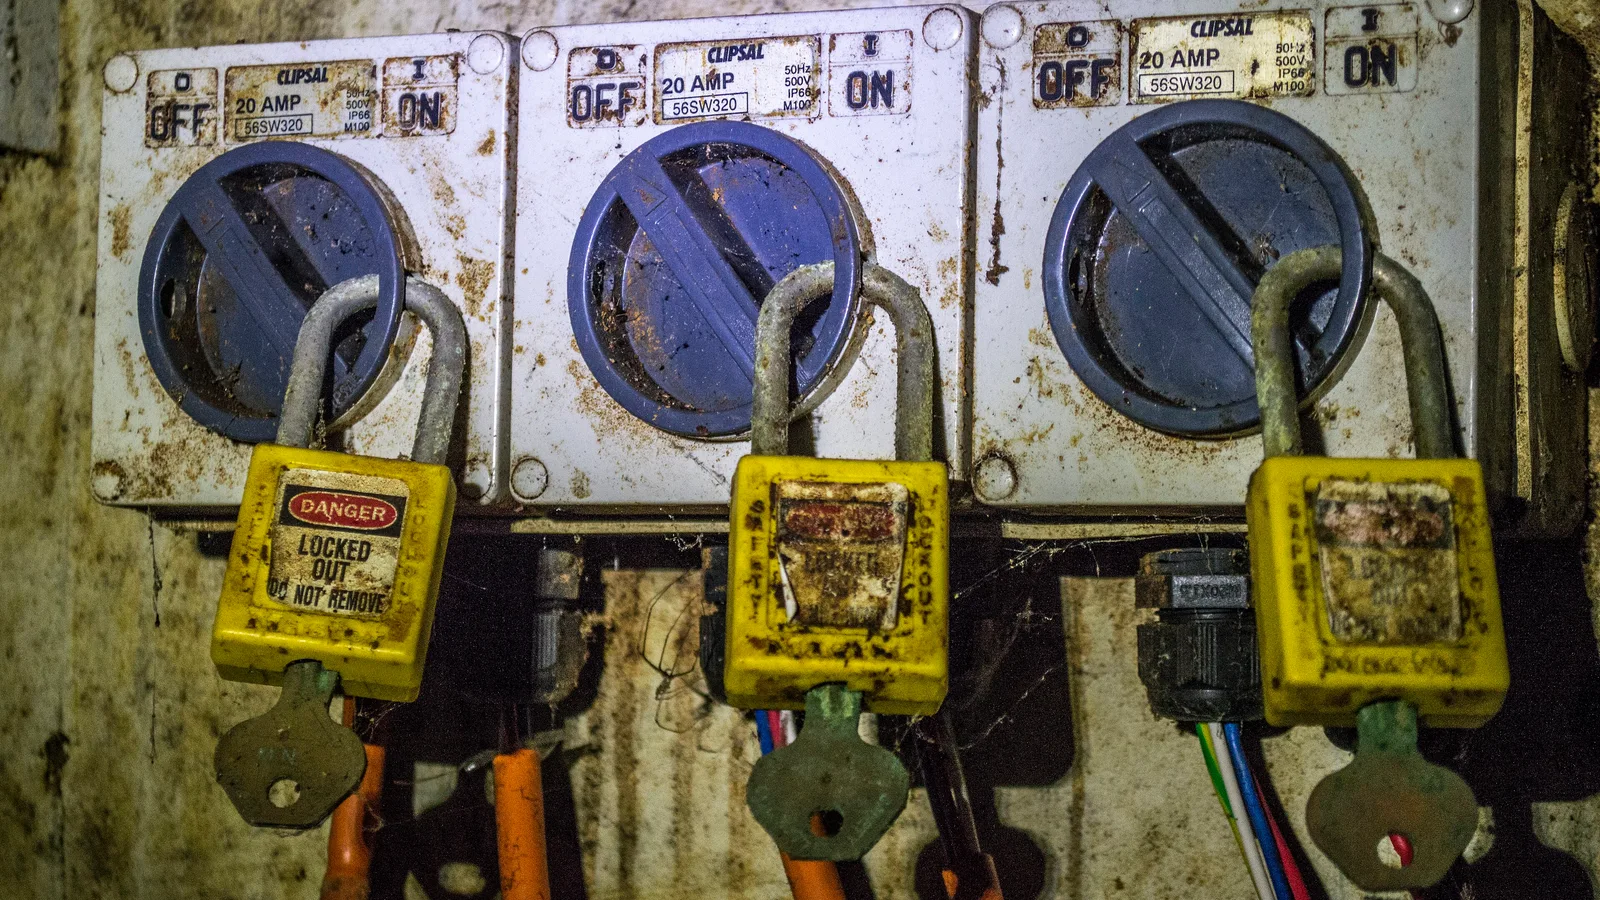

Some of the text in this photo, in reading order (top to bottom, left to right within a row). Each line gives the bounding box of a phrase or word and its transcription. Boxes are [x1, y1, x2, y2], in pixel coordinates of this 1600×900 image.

[1190, 18, 1254, 38] CLIPSAL
[708, 44, 765, 64] CLIPSAL
[1139, 48, 1220, 69] 20 AMP
[1275, 55, 1305, 66] 500V
[784, 63, 811, 75] 50Hz
[1278, 68, 1305, 79] IP66
[1344, 45, 1398, 87] ON
[277, 67, 329, 86] CLIPSAL
[662, 72, 735, 94] 20 AMP
[784, 75, 811, 87] 500V
[1039, 59, 1115, 101] OFF
[1150, 75, 1222, 93] 56SW320
[1273, 80, 1305, 92] M100
[788, 88, 811, 98] IP66
[846, 69, 894, 110] ON
[235, 94, 301, 114] 20 AMP
[345, 100, 370, 110] 500V
[399, 91, 443, 132] ON
[571, 81, 641, 123] OFF
[672, 98, 737, 116] 56SW320
[783, 100, 811, 111] M100
[150, 103, 211, 142] OFF
[348, 110, 371, 121] IP66
[244, 118, 303, 135] 56SW320
[344, 121, 370, 132] M100
[300, 498, 387, 522] DANGER
[298, 533, 371, 563] LOCKED
[311, 558, 350, 583] OUT
[293, 585, 320, 608] NOT
[327, 588, 387, 615] REMOVE
